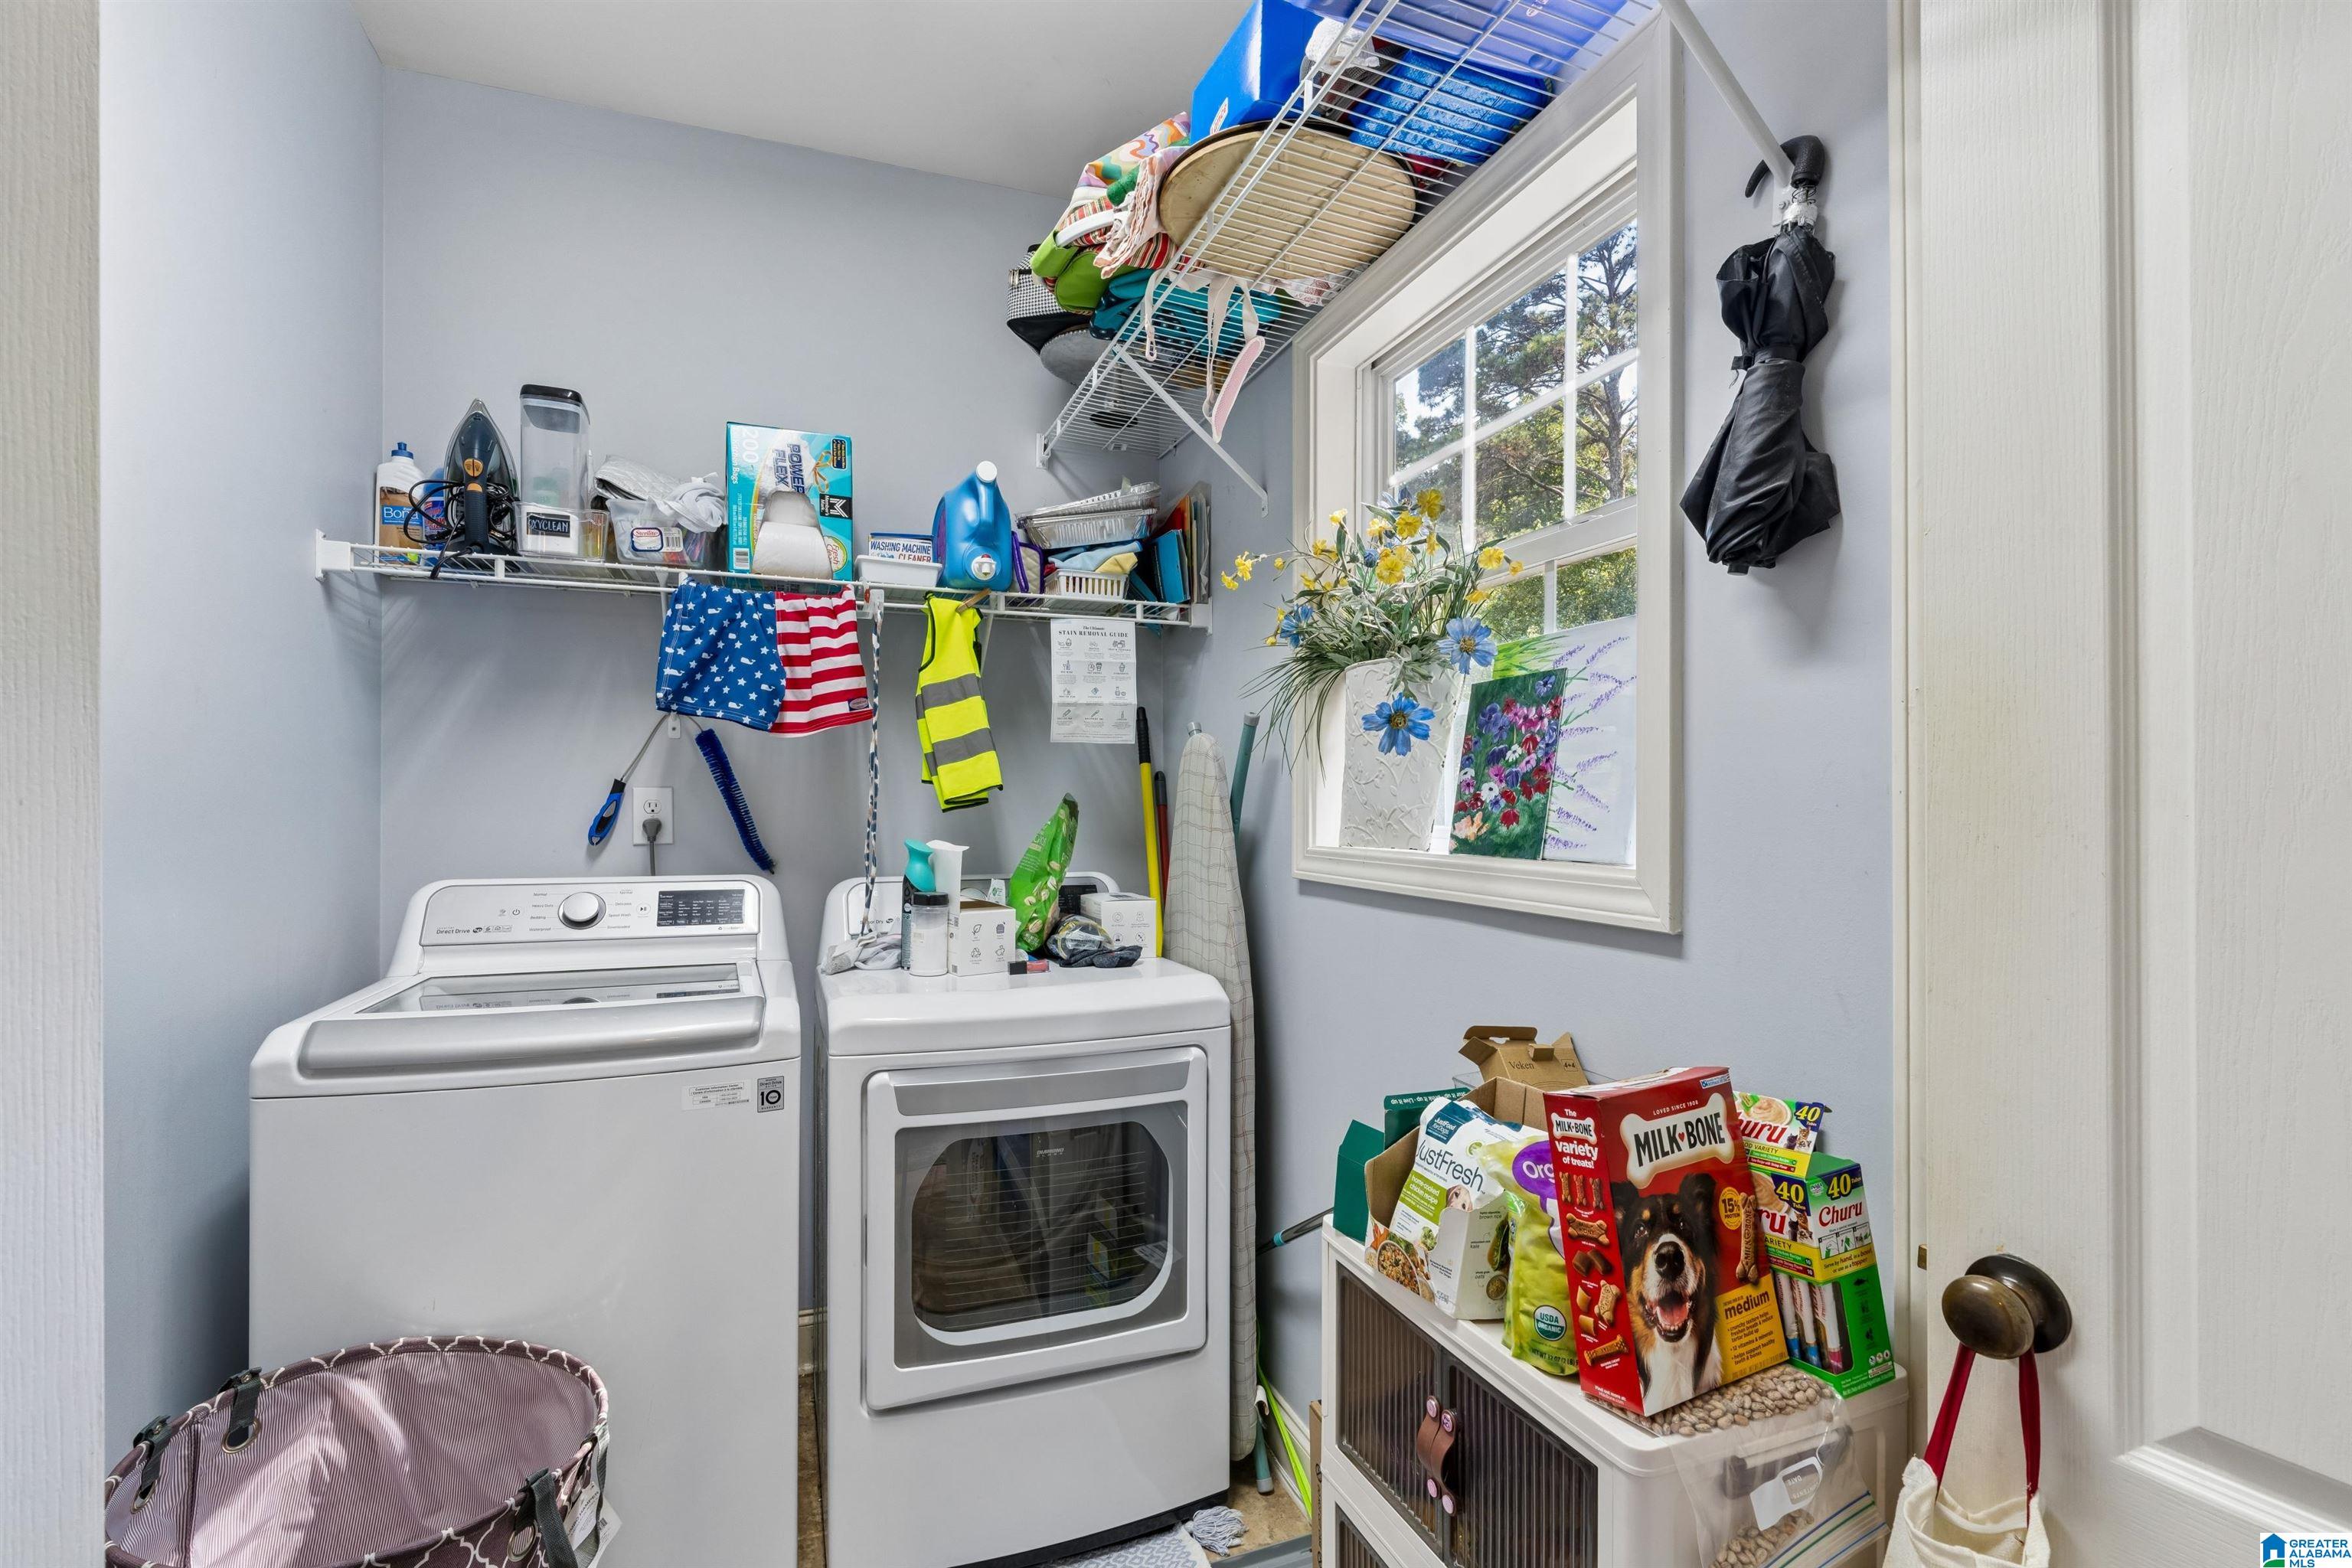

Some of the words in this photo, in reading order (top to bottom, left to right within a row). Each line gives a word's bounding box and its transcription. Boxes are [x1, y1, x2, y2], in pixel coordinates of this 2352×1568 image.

[731, 467, 740, 485] Bags
[773, 449, 789, 488] FLEX
[870, 540, 900, 552] WASHING
[901, 543, 932, 555] MACHINE
[1508, 1060, 1535, 1070] Veken
[1564, 1109, 1577, 1117] The
[1653, 1107, 1670, 1116] LOVED
[1671, 1102, 1686, 1111] SINCE
[1795, 1105, 1821, 1122] 40
[1554, 1140, 1599, 1161] variety
[1754, 1143, 1779, 1154] VARIETY
[1570, 1158, 1595, 1169] treats!
[1775, 1181, 1805, 1204] 40
[1828, 1173, 1851, 1199] 40
[1721, 1197, 1741, 1214] 15%
[1818, 1201, 1863, 1227] Churu
[1765, 1236, 1792, 1250] ARIETY
[1724, 1290, 1770, 1320] medium
[1539, 1312, 1560, 1324] USDA
[1537, 1321, 1562, 1334] ORGANIC
